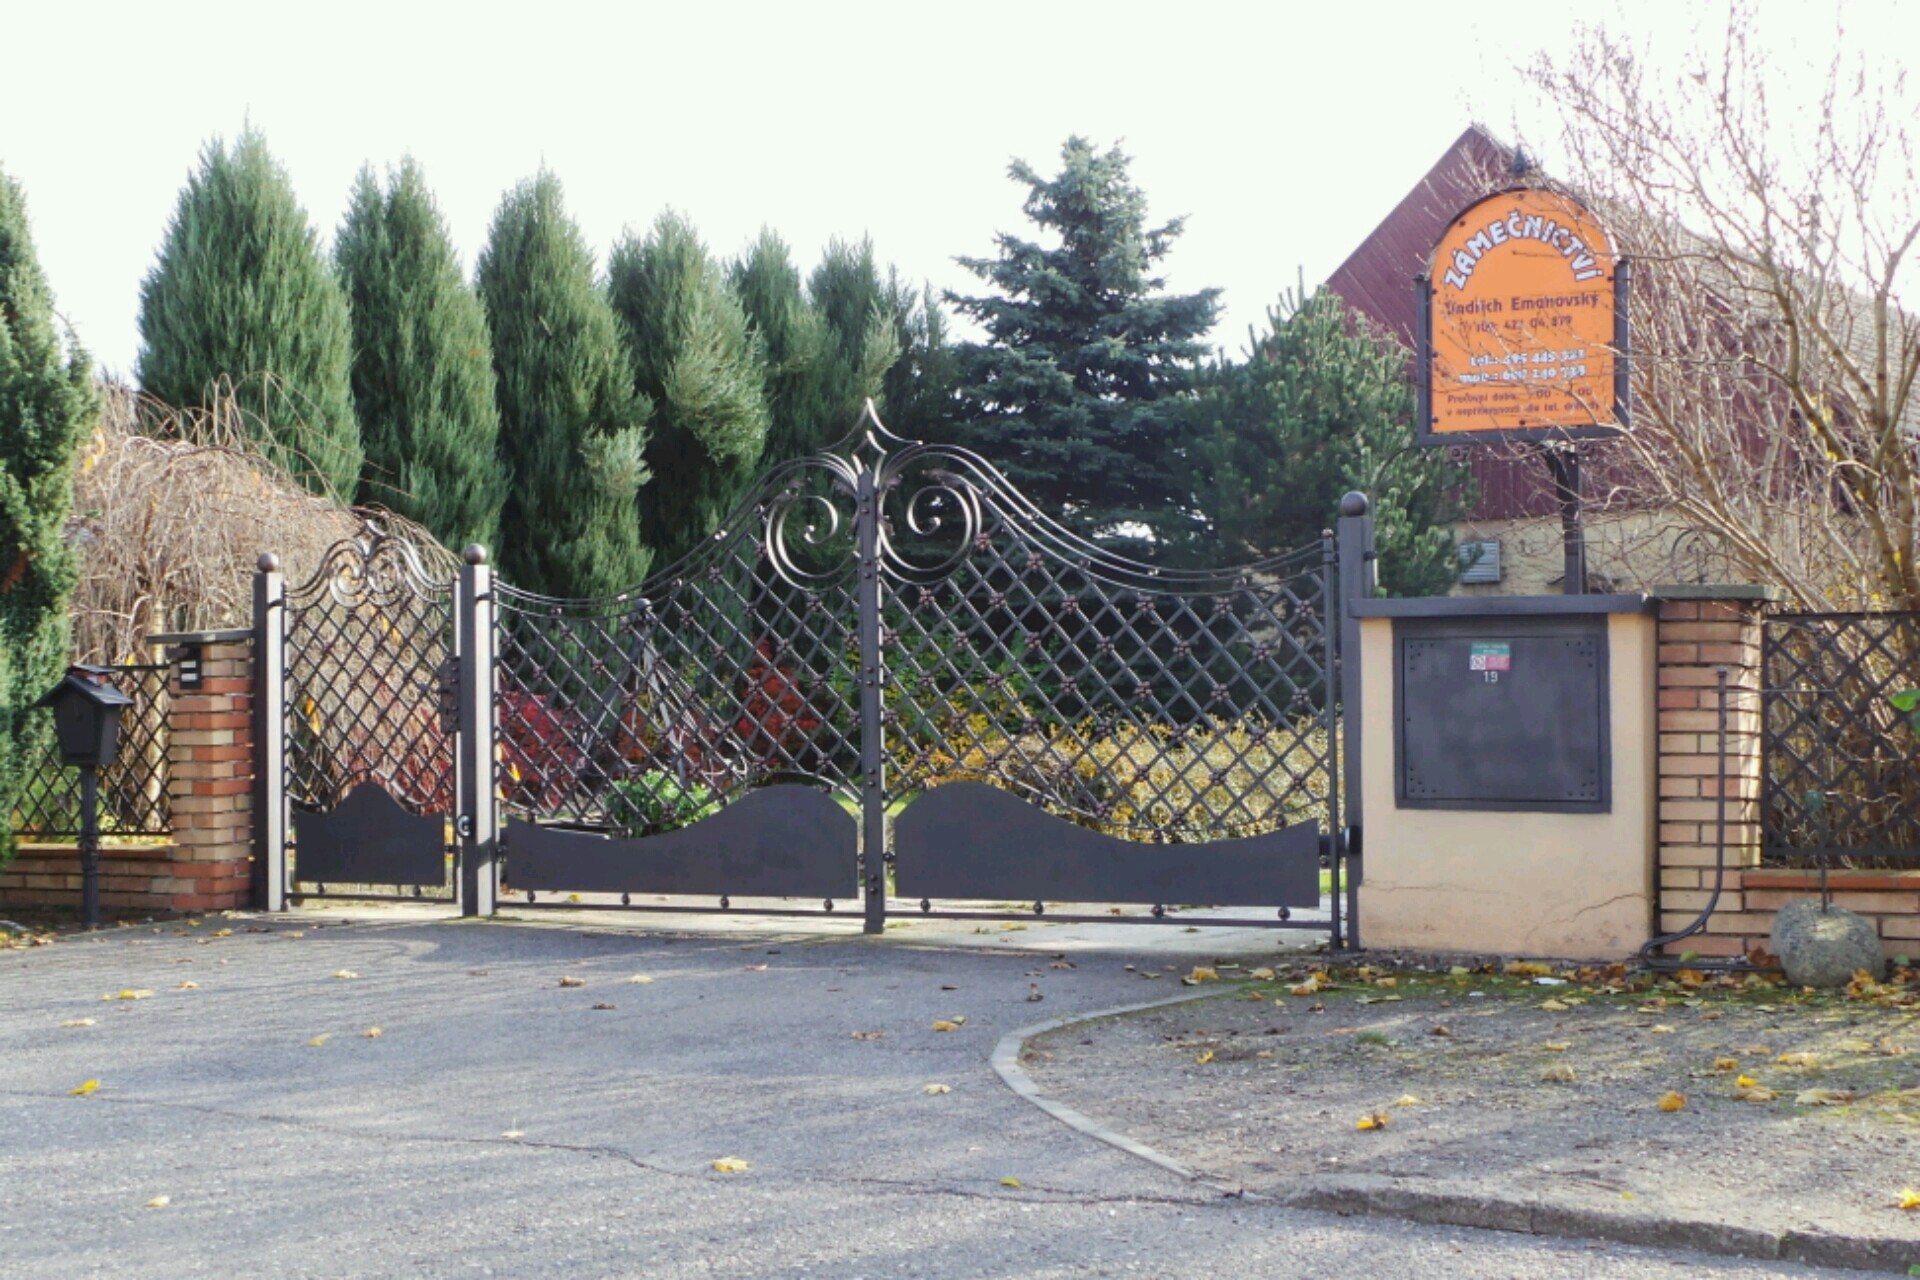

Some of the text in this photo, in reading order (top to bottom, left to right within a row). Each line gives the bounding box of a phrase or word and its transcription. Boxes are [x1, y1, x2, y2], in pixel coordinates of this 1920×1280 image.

[1444, 209, 1604, 290] ZÁMEČNICTVÍ
[1511, 293, 1600, 313] Emanovský
[1483, 670, 1499, 684] 19
